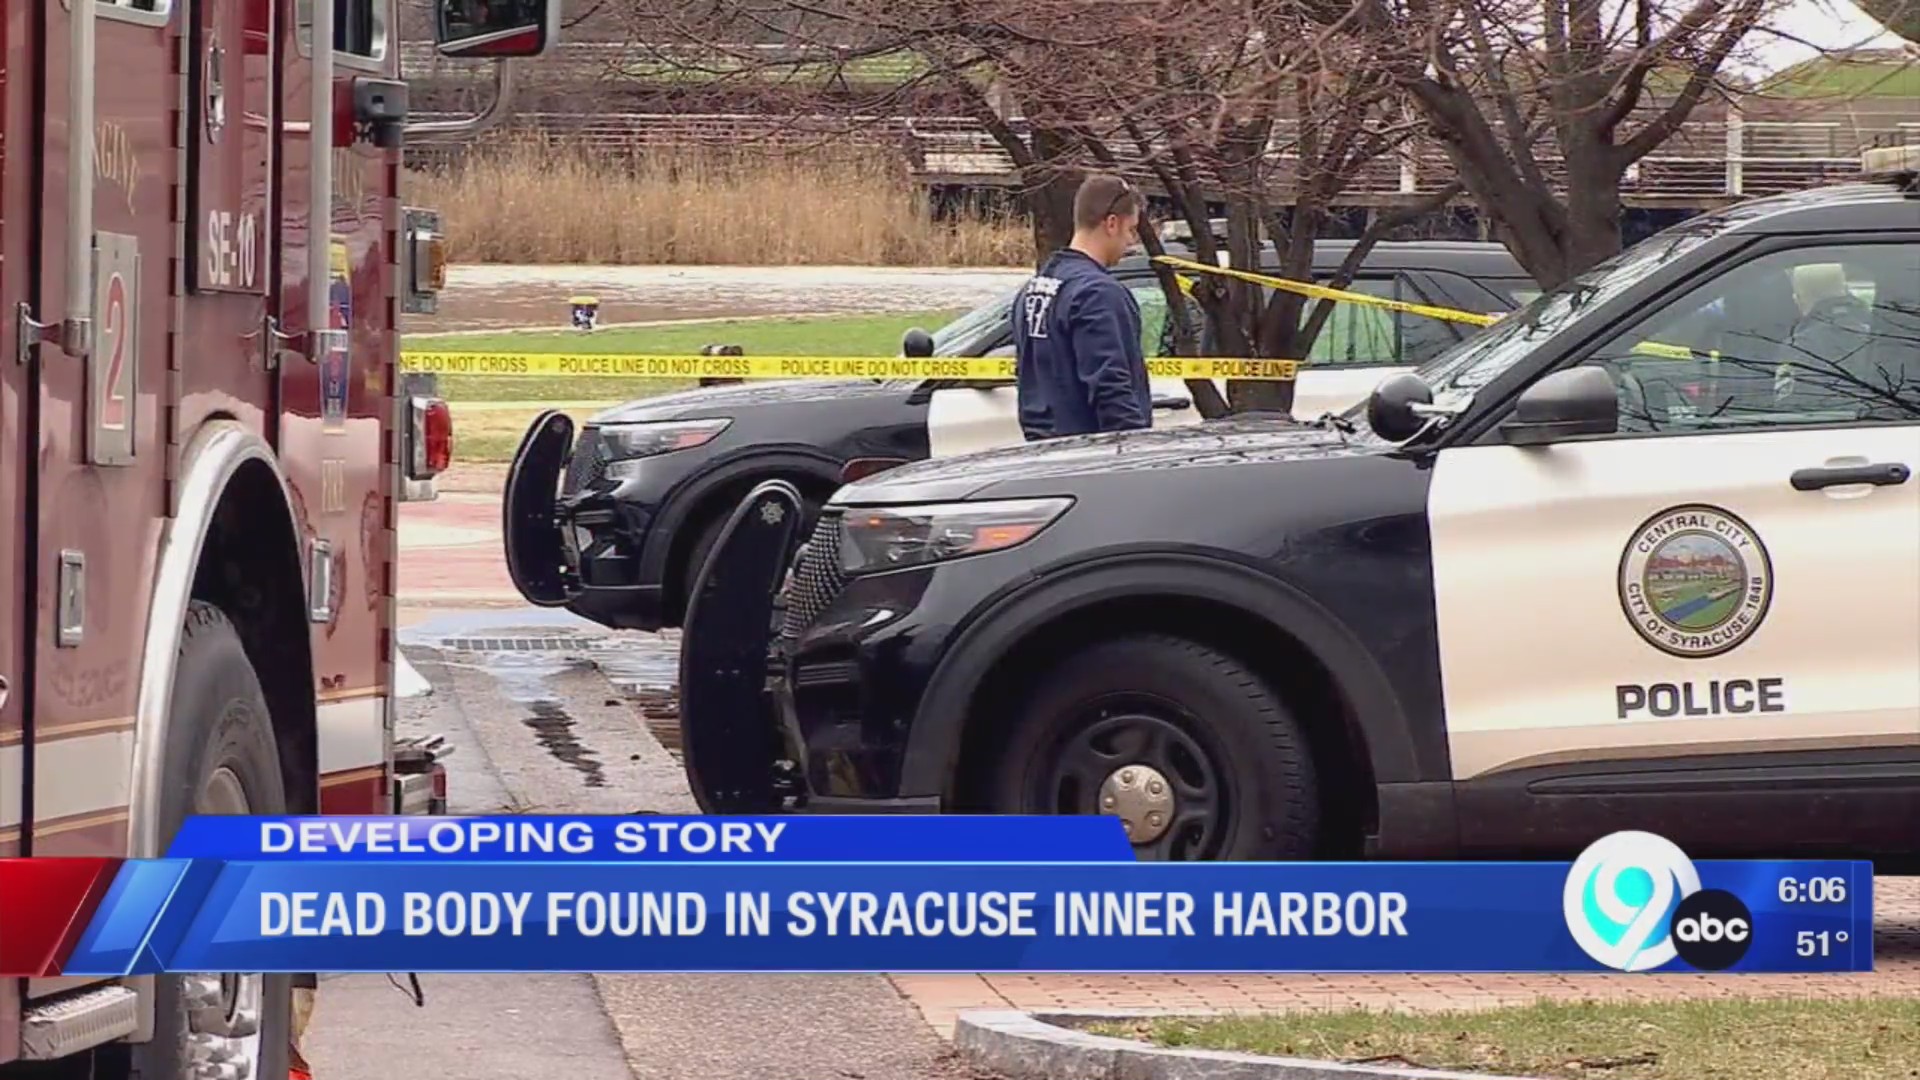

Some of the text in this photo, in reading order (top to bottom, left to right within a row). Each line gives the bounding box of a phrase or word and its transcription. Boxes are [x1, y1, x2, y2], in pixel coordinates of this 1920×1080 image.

[207, 209, 256, 288] SE-10
[102, 271, 126, 431] 2
[400, 356, 528, 372] NE DO NOT CROSS
[559, 357, 750, 375] POLICE LINE DO NOT CROSS
[781, 359, 968, 377] POLICE LINE DO NOT CROSS
[1147, 360, 1183, 376] ROSS
[1211, 361, 1293, 378] POLICE LINE
[1638, 515, 1750, 553] CENTRAL CITY
[1628, 582, 1649, 616] CITY
[1646, 618, 1669, 636] OF
[1668, 611, 1752, 648] SYRACUSE
[1616, 677, 1784, 719] POLICE
